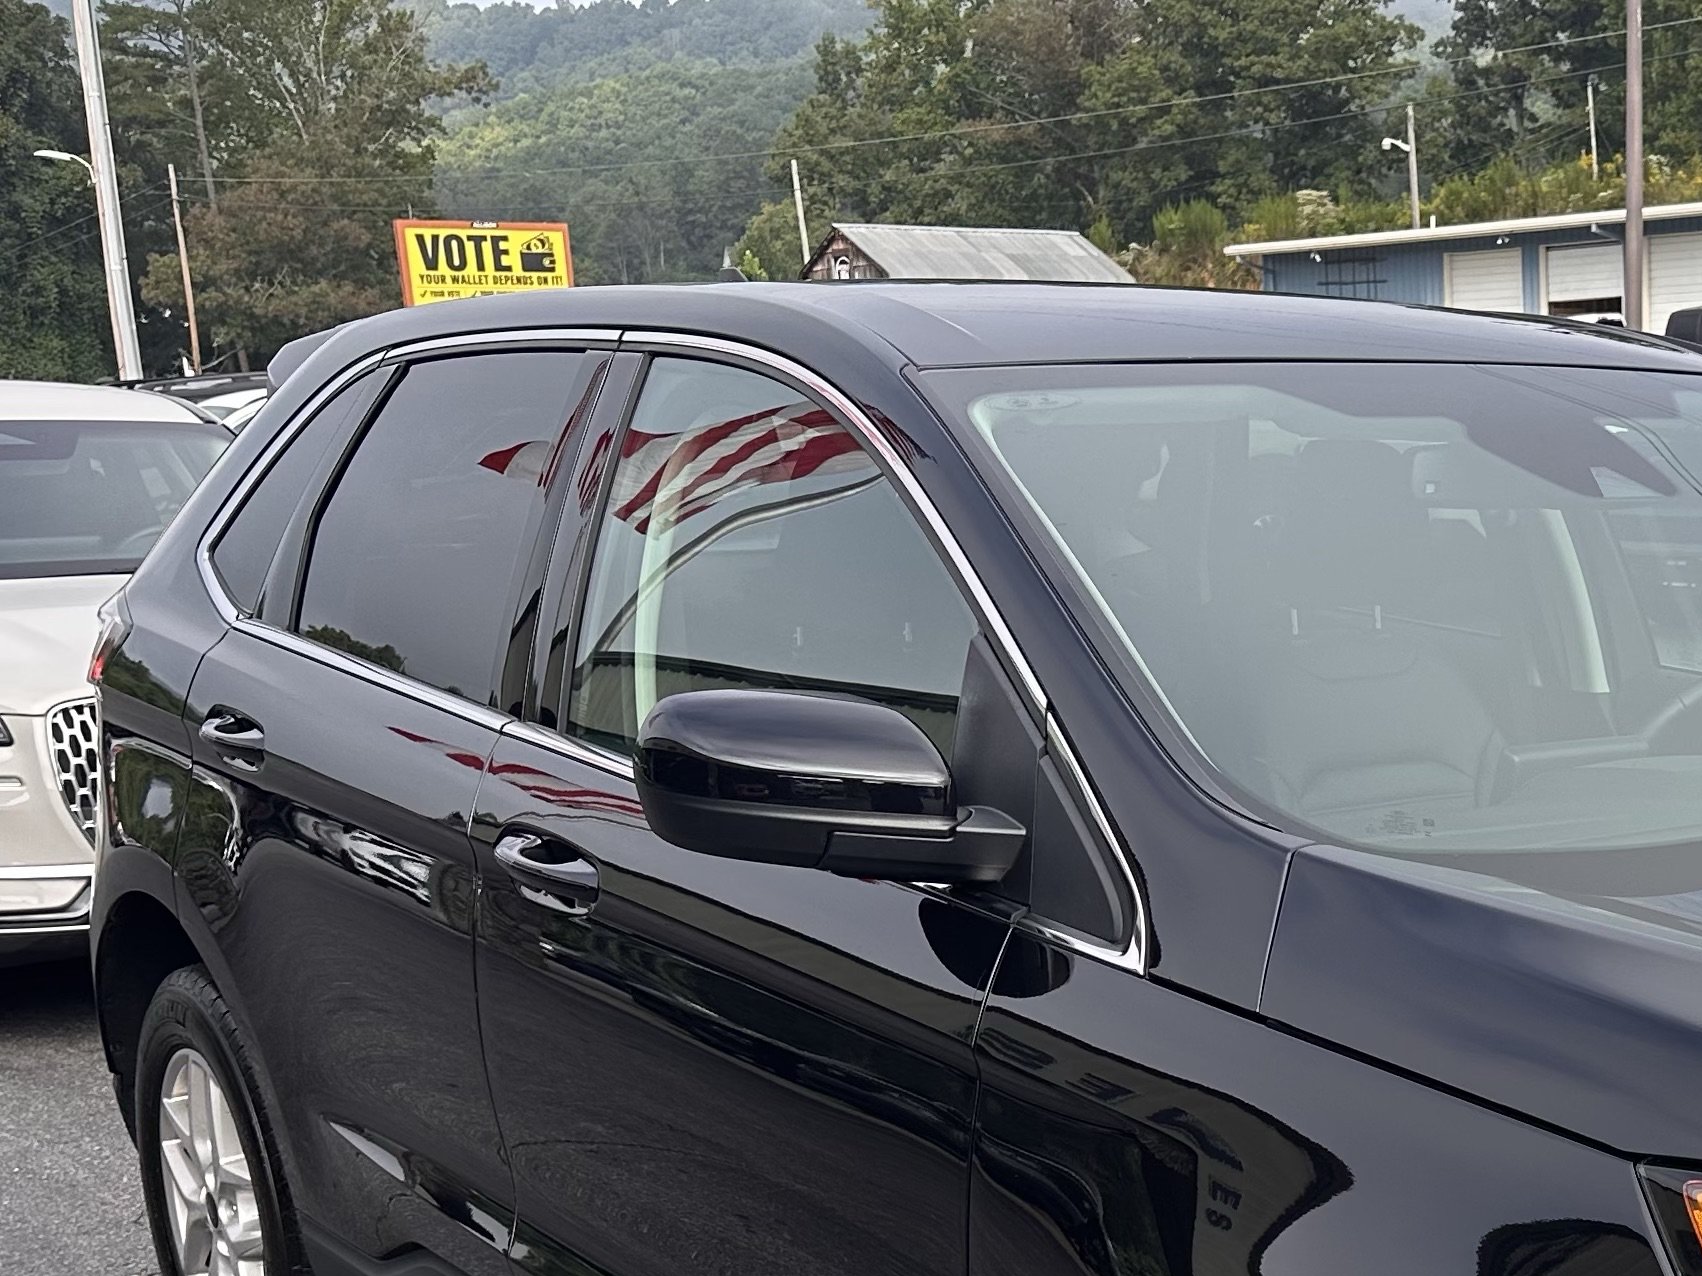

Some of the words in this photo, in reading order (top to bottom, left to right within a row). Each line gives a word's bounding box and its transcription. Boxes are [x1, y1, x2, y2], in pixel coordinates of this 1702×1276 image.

[415, 234, 513, 272] VOTE
[419, 274, 447, 285] YOUR
[450, 274, 489, 286] WALLET
[493, 275, 534, 286] DEPENDS
[537, 276, 549, 286] ON
[552, 276, 563, 286] IT!
